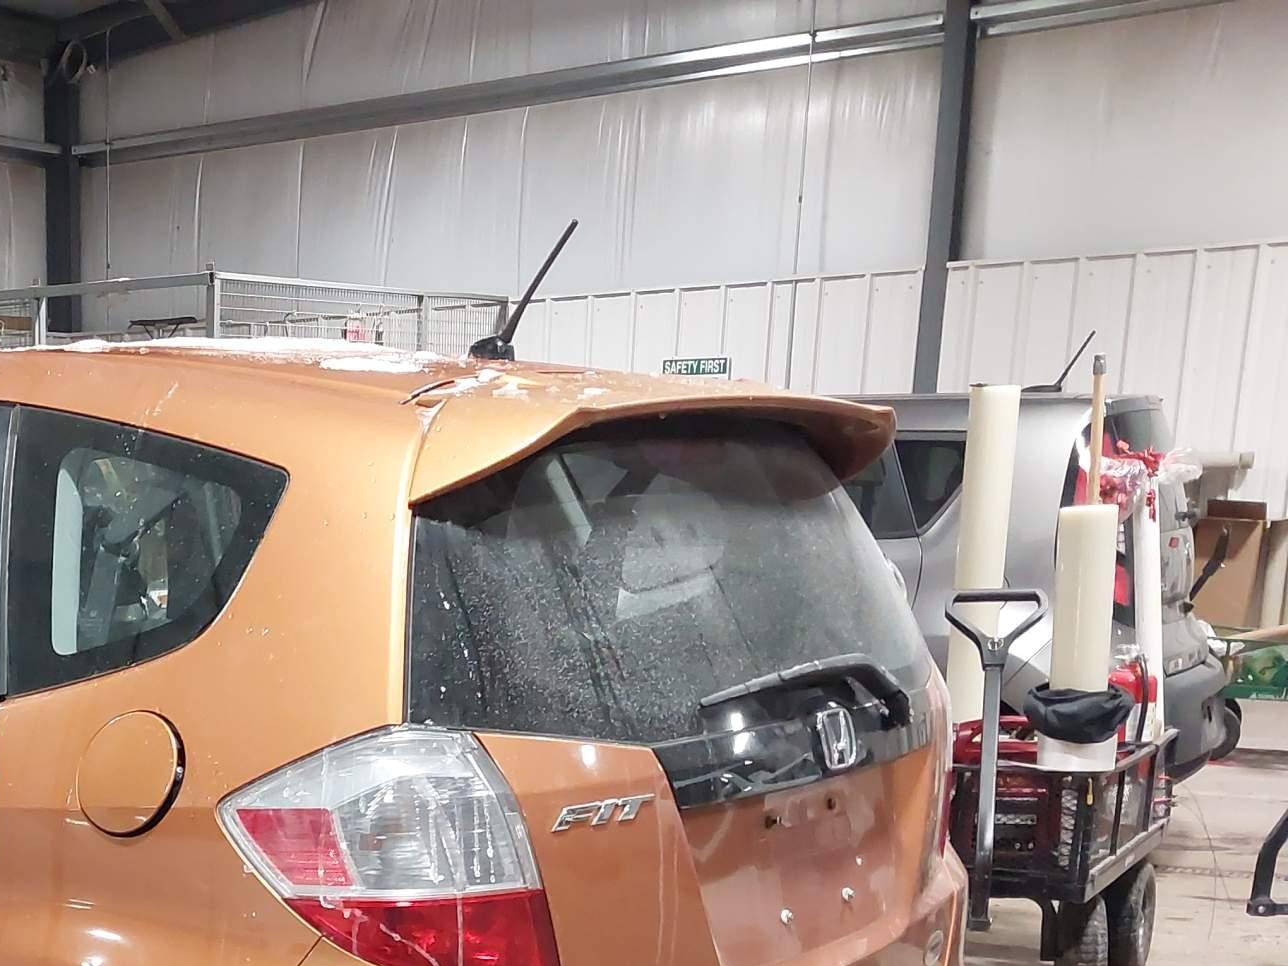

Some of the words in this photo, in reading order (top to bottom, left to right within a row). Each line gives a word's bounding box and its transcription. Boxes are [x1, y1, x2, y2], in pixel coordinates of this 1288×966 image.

[664, 360, 699, 374] SAFETY
[699, 359, 726, 373] FIRST
[551, 793, 655, 833] FIT
